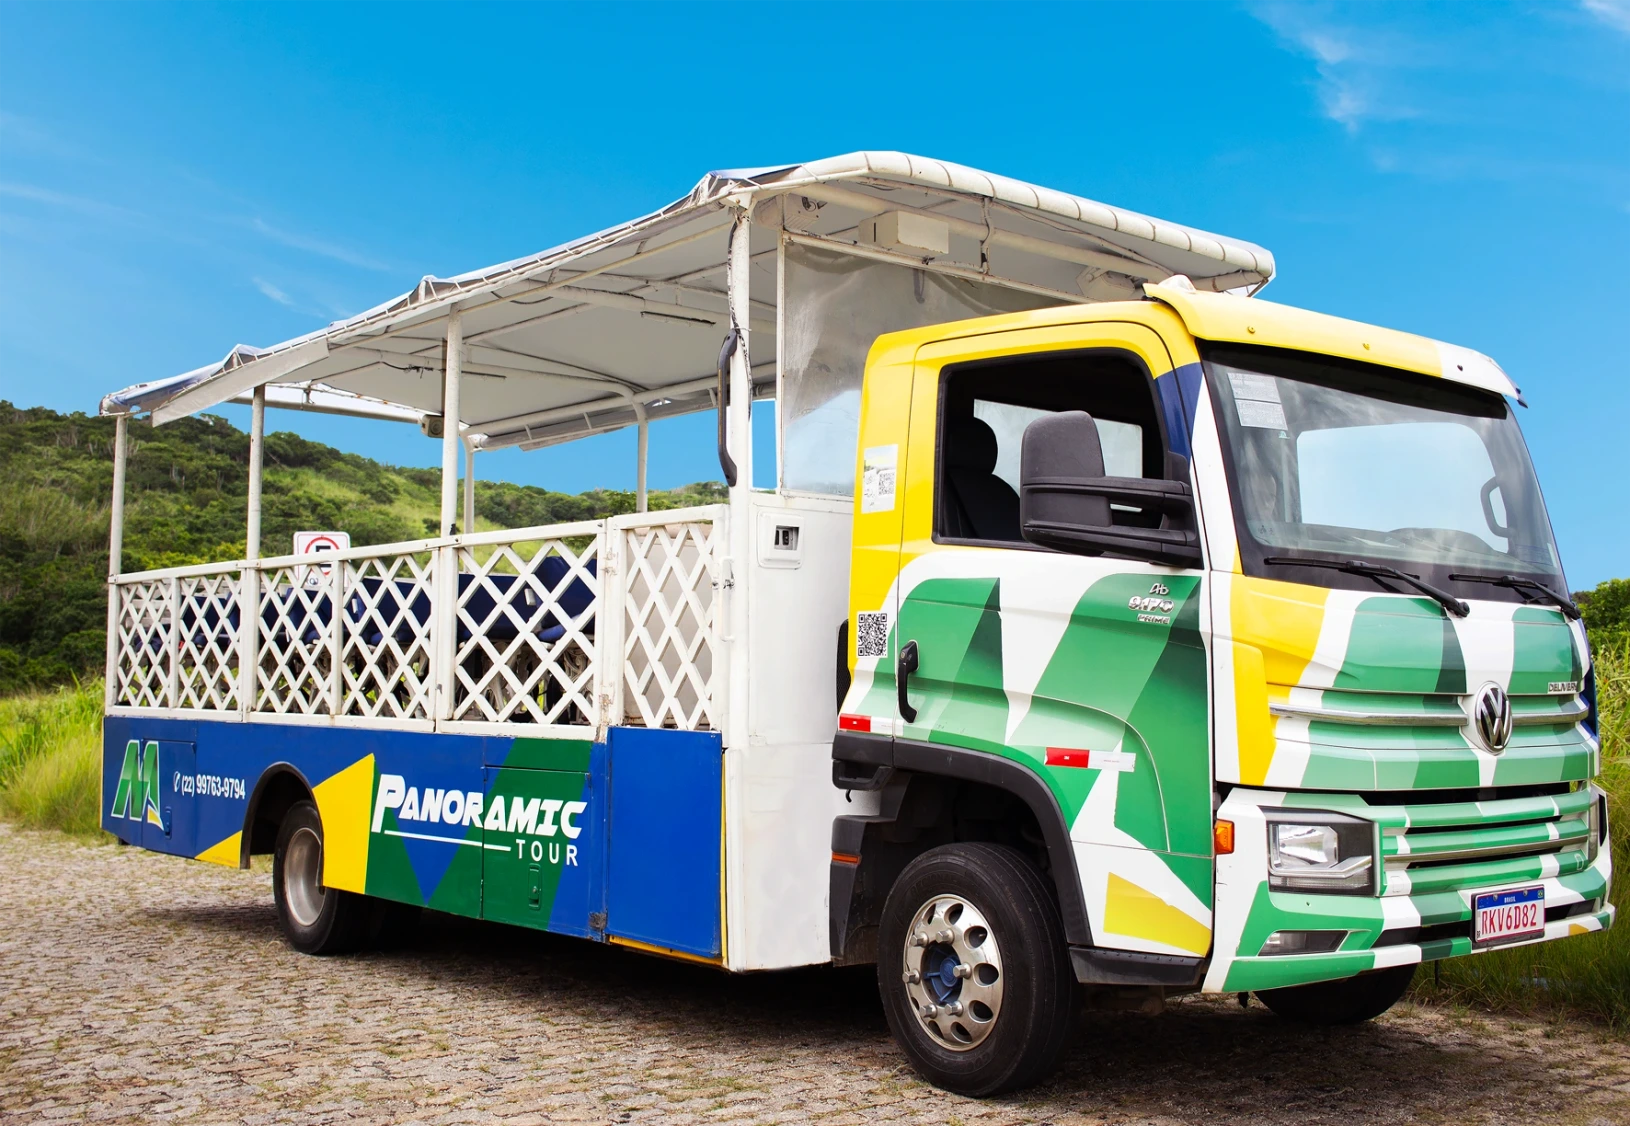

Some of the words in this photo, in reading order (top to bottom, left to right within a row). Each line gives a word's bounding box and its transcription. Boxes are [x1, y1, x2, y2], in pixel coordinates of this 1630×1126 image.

[1137, 613, 1170, 625] PRIME
[1548, 682, 1578, 694] DELIVERY
[181, 775, 195, 797] (22)
[196, 774, 246, 799] 99763-9794
[371, 774, 588, 839] PANORAMIC
[515, 838, 579, 867] TOUR
[1481, 903, 1537, 935] RKV6D82
